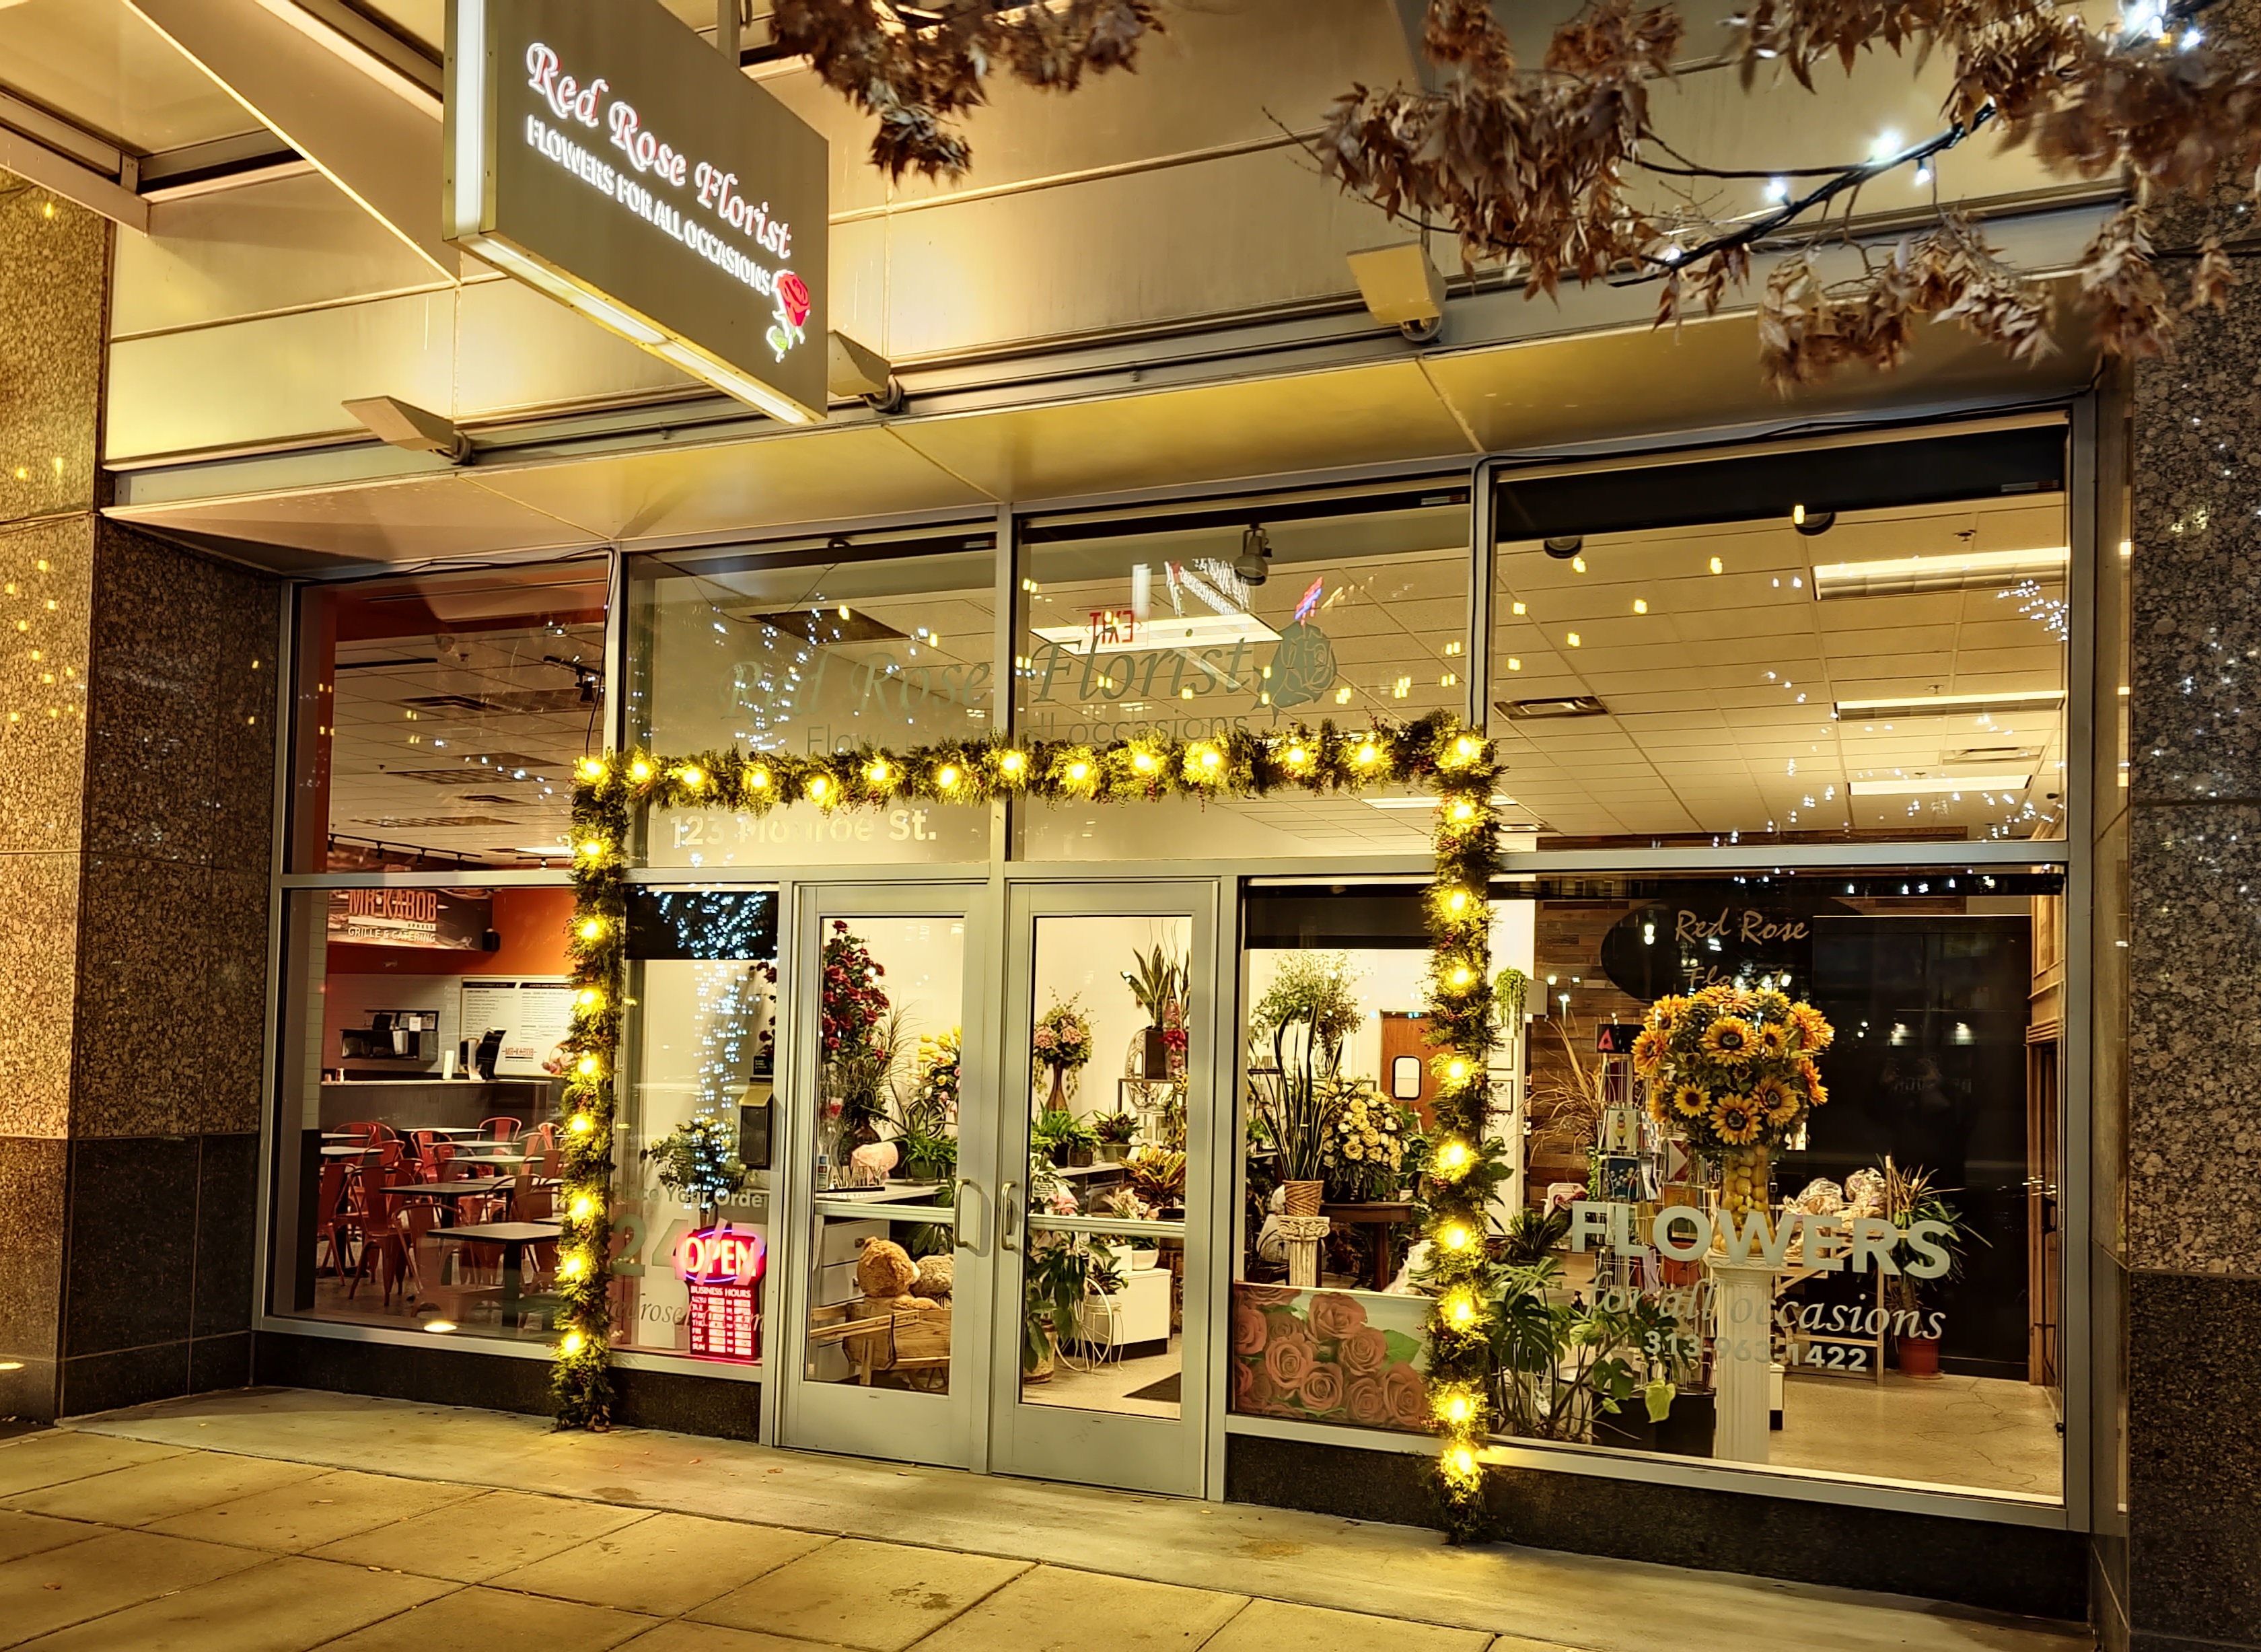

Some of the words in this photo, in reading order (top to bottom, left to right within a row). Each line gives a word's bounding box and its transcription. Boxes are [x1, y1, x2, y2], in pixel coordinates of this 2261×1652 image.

[527, 42, 609, 128] Red
[609, 101, 688, 187] Rose
[694, 161, 793, 260] Florist
[527, 113, 616, 196] FLOWERS
[616, 173, 653, 223] FOR
[653, 200, 684, 242] ALL
[683, 219, 773, 296] OCCASIONS
[718, 644, 842, 730] Red
[851, 651, 991, 725] Rose
[1030, 628, 1256, 703] Florist
[670, 815, 725, 847] 123
[888, 809, 937, 842] St.
[382, 888, 437, 922] KABOB
[348, 927, 381, 939] GRILLE
[392, 931, 436, 943] CATERING
[1676, 907, 1731, 943] Red
[1741, 910, 1809, 945] Rose
[685, 1237, 756, 1277] OPEN
[1572, 1200, 1951, 1279] FLOWERS
[724, 1288, 752, 1298] HOURS
[1585, 1270, 1648, 1318] for
[1659, 1278, 1723, 1321] all
[1730, 1293, 1947, 1340] occasions
